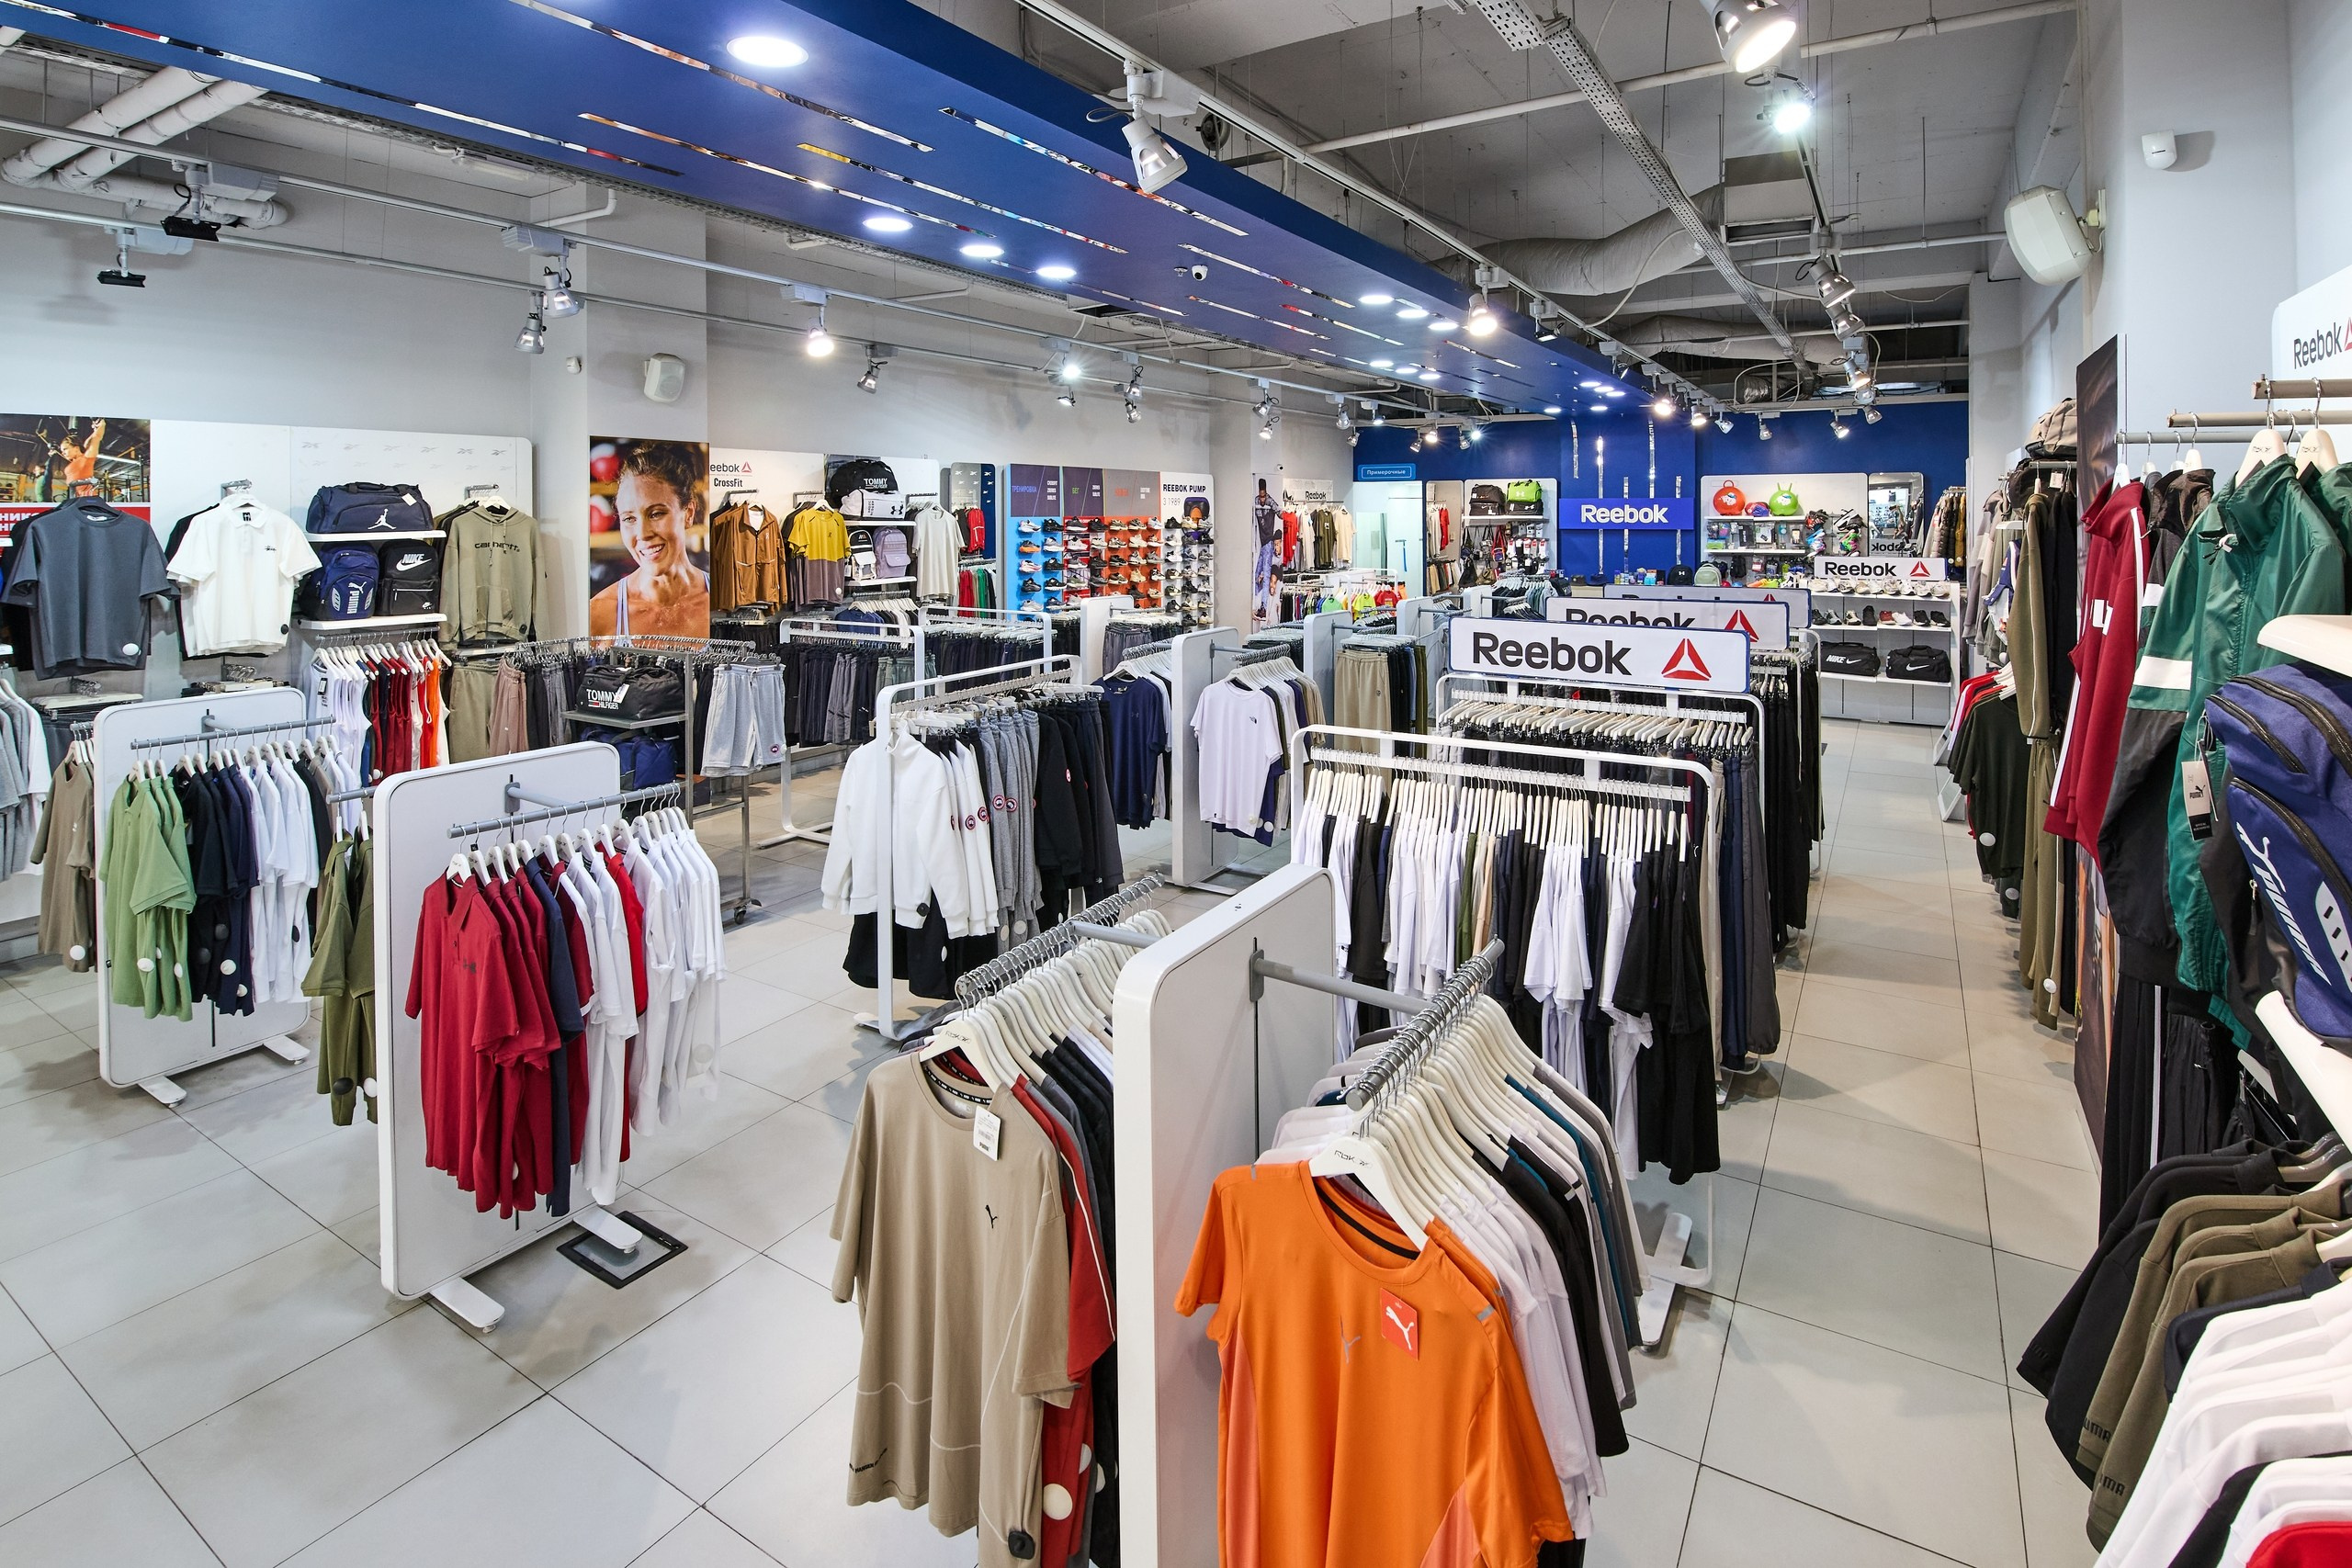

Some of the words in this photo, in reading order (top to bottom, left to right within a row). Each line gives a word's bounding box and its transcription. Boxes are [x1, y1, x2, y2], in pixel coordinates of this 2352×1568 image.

[2293, 322, 2343, 369] Reebok
[709, 463, 740, 473] eebok
[714, 478, 742, 488] CrossFit
[1163, 484, 1188, 492] REEBOK
[1305, 491, 1327, 501] Reebok
[1169, 498, 1181, 506] 1989
[1580, 504, 1668, 524] Reebok
[402, 553, 424, 564] NIKE
[1825, 561, 1897, 577] Reebok
[347, 591, 359, 615] PUMA
[1472, 631, 1633, 676] Reebok
[1826, 654, 1847, 663] NIKE
[586, 689, 617, 702] TOMMY
[599, 701, 619, 710] HILFIGER
